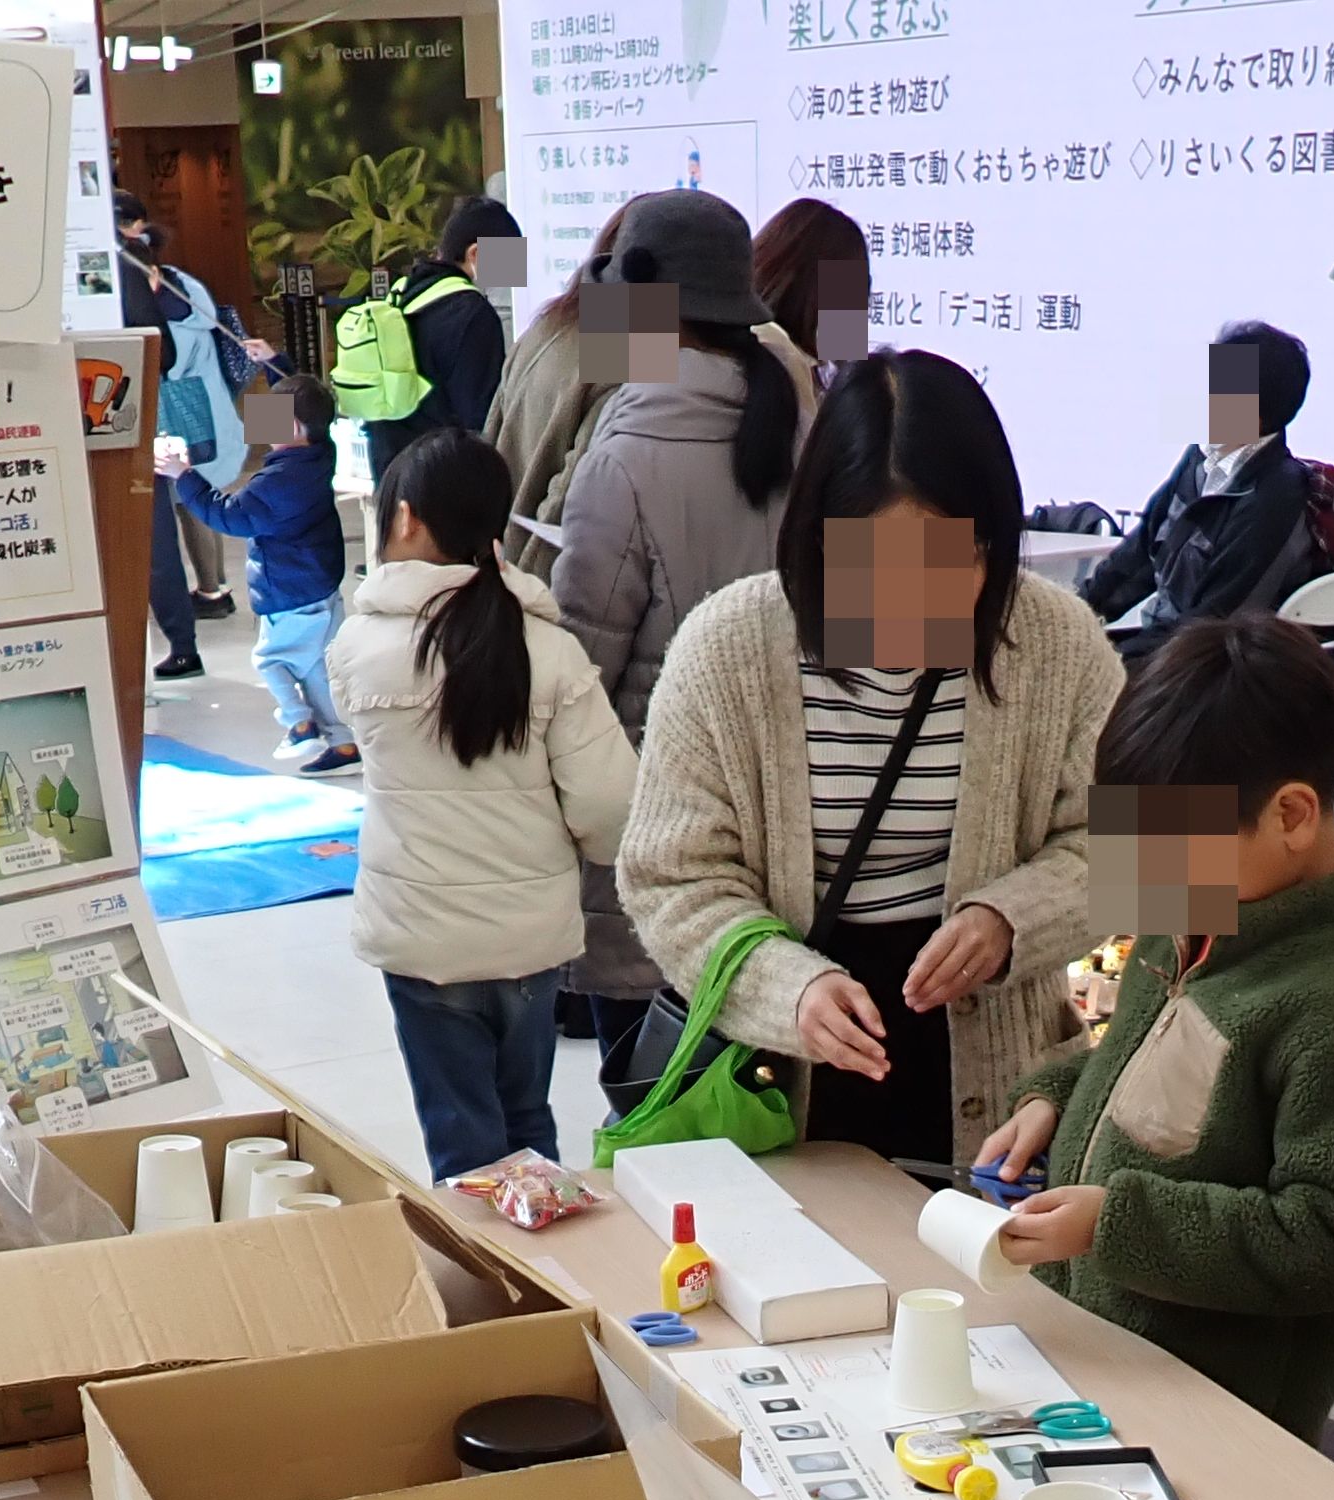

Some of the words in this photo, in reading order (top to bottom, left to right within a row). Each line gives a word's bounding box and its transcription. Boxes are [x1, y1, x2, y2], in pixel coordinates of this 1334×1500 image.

[321, 42, 378, 60] Green
[379, 40, 411, 60] leaf
[415, 38, 454, 58] cafe
[806, 74, 951, 121] 海の生き物遊び
[807, 141, 1113, 190] 太陽光発電で動くおもちゃ遊び
[890, 220, 976, 258] 釣堀体験
[89, 893, 128, 914] デコ活
